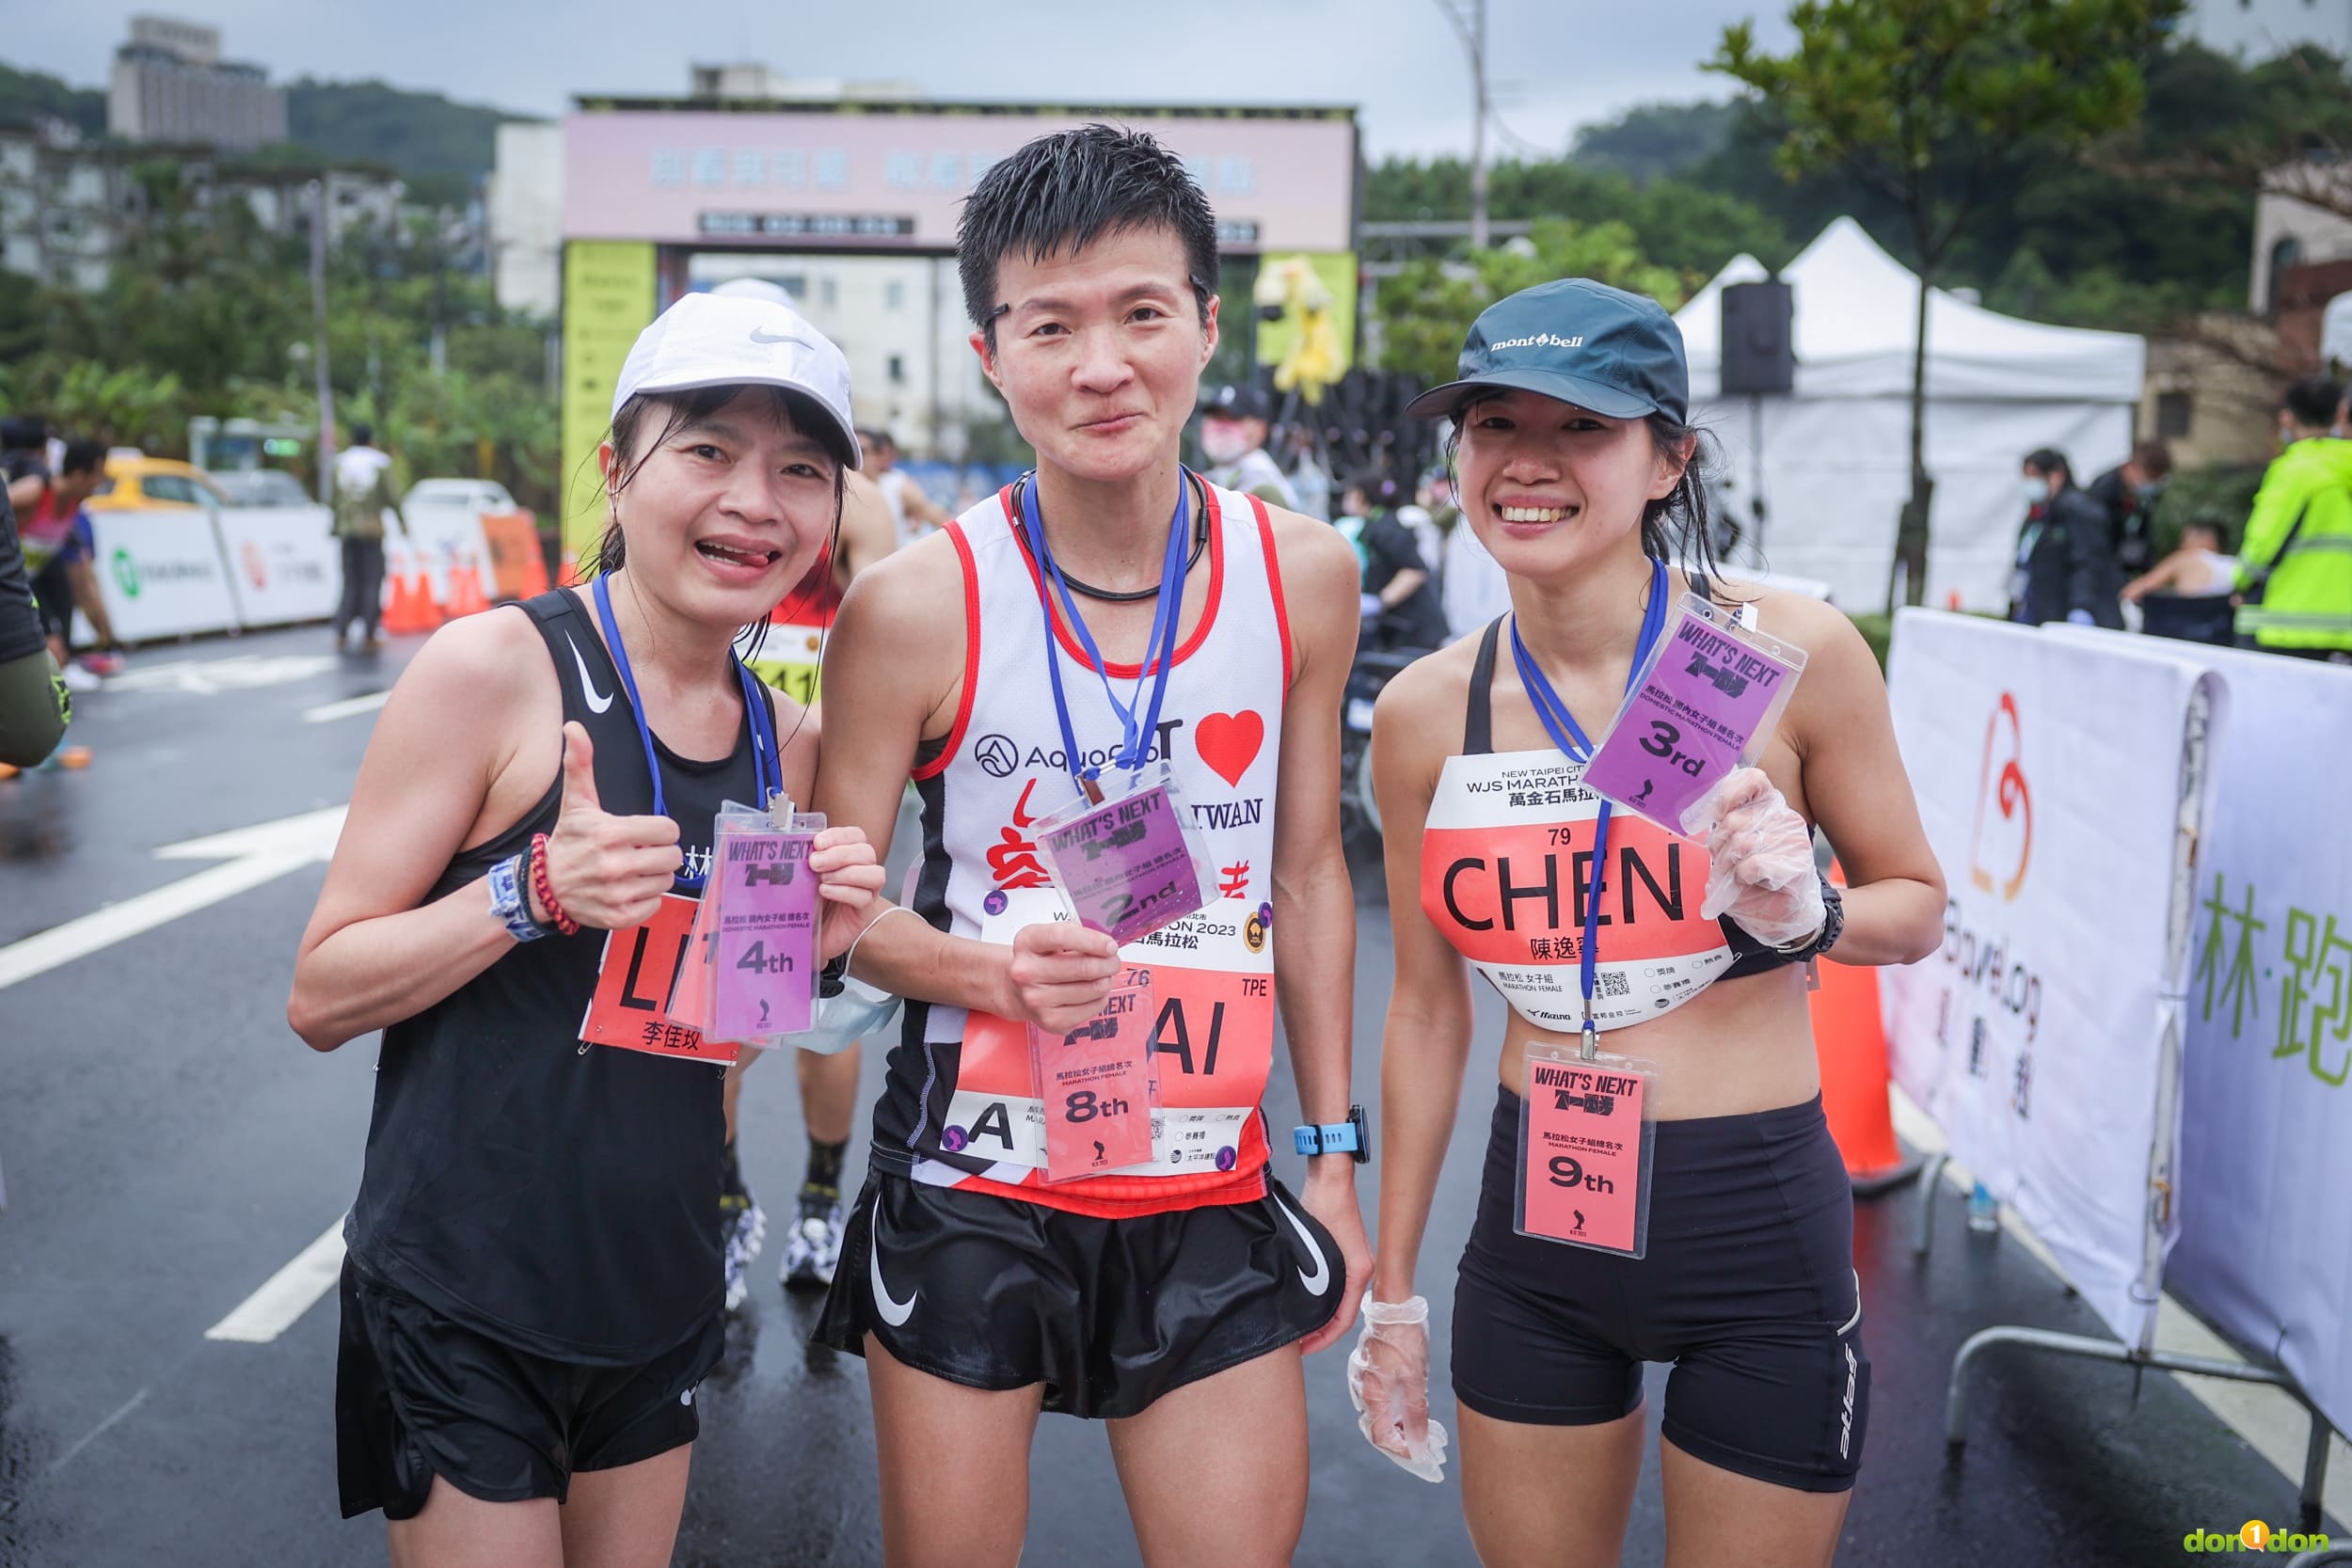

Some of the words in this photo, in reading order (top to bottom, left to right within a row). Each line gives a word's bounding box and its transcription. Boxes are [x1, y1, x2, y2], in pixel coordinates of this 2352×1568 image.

[1677, 621, 1739, 665] WHAT'S
[1734, 651, 1780, 688] NEXT
[1640, 692, 1676, 715] DOMESTIC
[1675, 711, 1713, 736] MARATHON
[1712, 733, 1740, 752] FEMALE
[1639, 720, 1706, 778] 3rd
[1466, 781, 1503, 793] WJS
[1506, 774, 1580, 791] MARATH
[1502, 769, 1528, 779] NEW
[1530, 767, 1565, 777] TAIPEI
[1566, 765, 1585, 773] CIT
[1508, 787, 1599, 807] 萬金石馬拉
[1052, 812, 1115, 852] WHAT'S
[1118, 792, 1161, 821] NEXT
[1548, 827, 1572, 847] 79
[727, 840, 777, 863] WHAT'S
[780, 839, 814, 861] NEXT
[1442, 843, 1685, 931] CHEN
[1100, 879, 1177, 928] 2nd
[1196, 923, 1236, 937] 2023
[736, 940, 794, 974] 4th
[1126, 968, 1151, 988] 76
[1242, 978, 1267, 997] TPE
[1502, 982, 1537, 992] MARATHON
[1062, 1075, 1100, 1086] MARATHON
[1100, 1069, 1127, 1079] FEMALE
[1534, 1067, 1593, 1091] WHAT'S
[1596, 1075, 1638, 1097] NEXT
[1065, 1089, 1129, 1123] 8th
[968, 1101, 1014, 1150] A
[1542, 1131, 1624, 1151] 馬拉松女子組總名次
[1548, 1141, 1587, 1152] MARATHON
[1588, 1148, 1617, 1157] FEMALE
[1548, 1155, 1614, 1195] 9th
